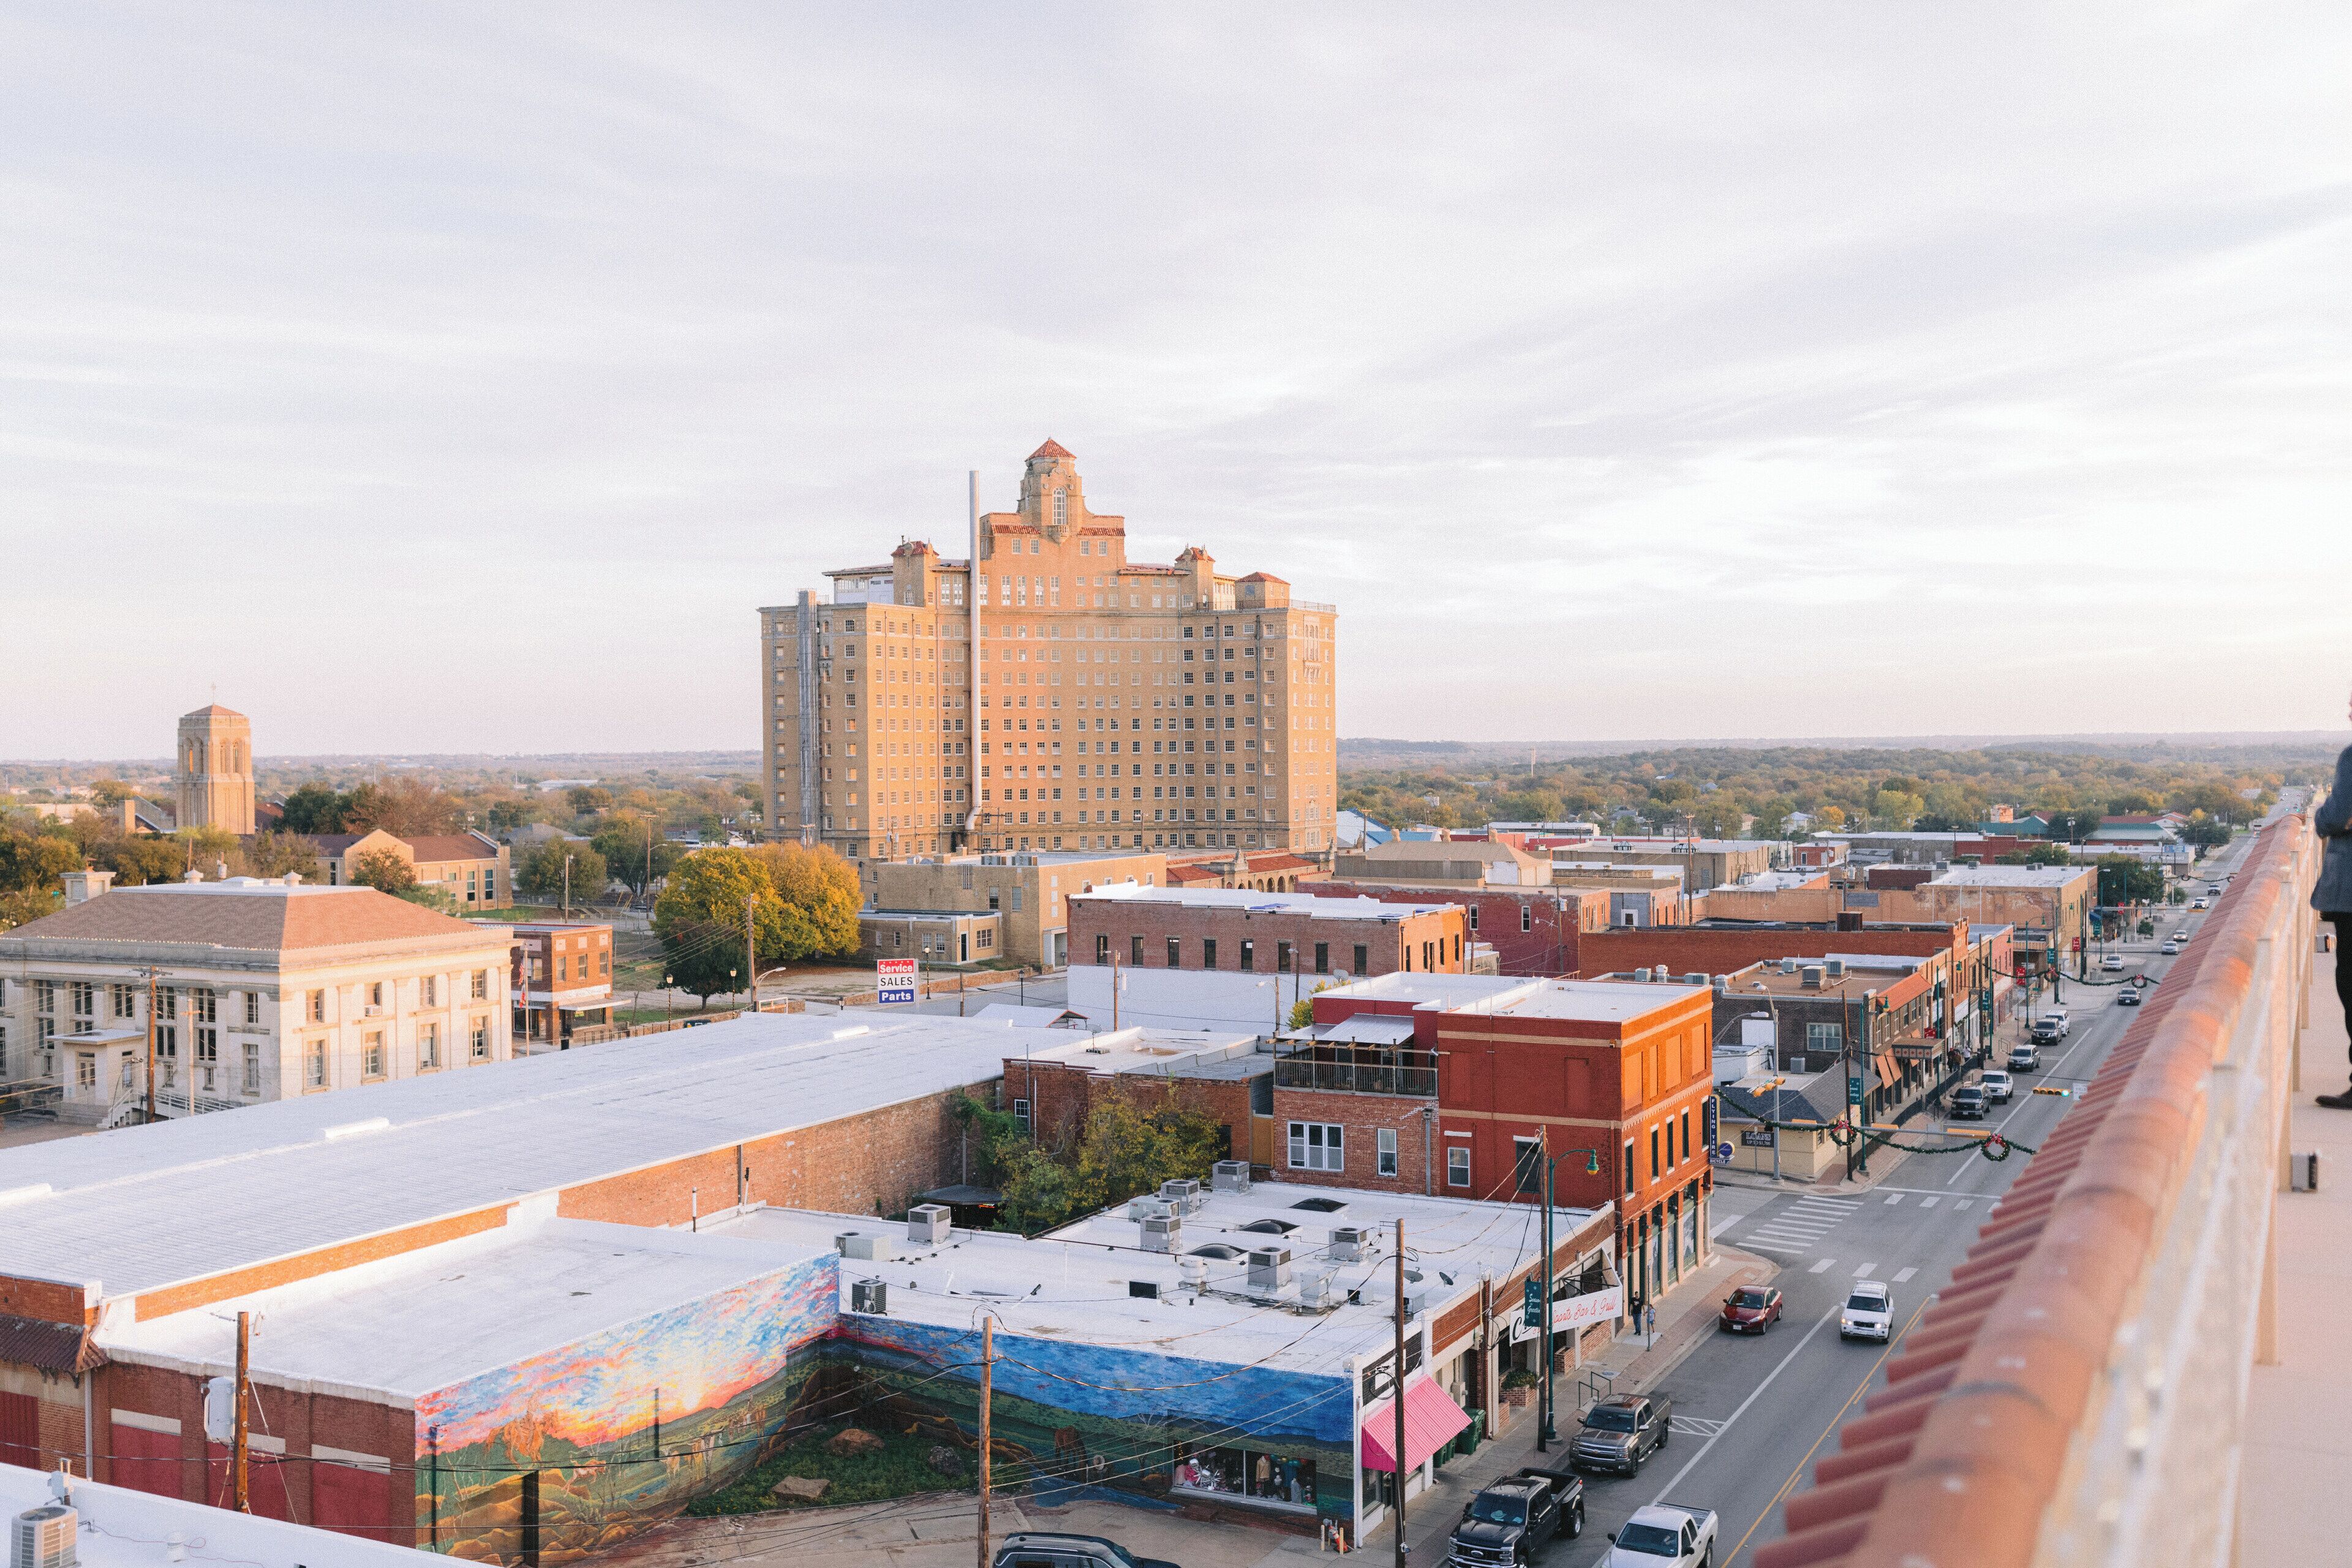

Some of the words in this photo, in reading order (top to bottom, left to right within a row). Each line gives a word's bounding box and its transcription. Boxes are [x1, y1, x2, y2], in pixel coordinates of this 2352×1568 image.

[880, 963, 913, 973] Service
[880, 976, 913, 986] SALES
[881, 992, 911, 1001] Parts
[1746, 1132, 1771, 1140] LOANS
[1574, 1304, 1589, 1320] Bar
[1590, 1300, 1597, 1316] &
[1599, 1294, 1617, 1315] Grill
